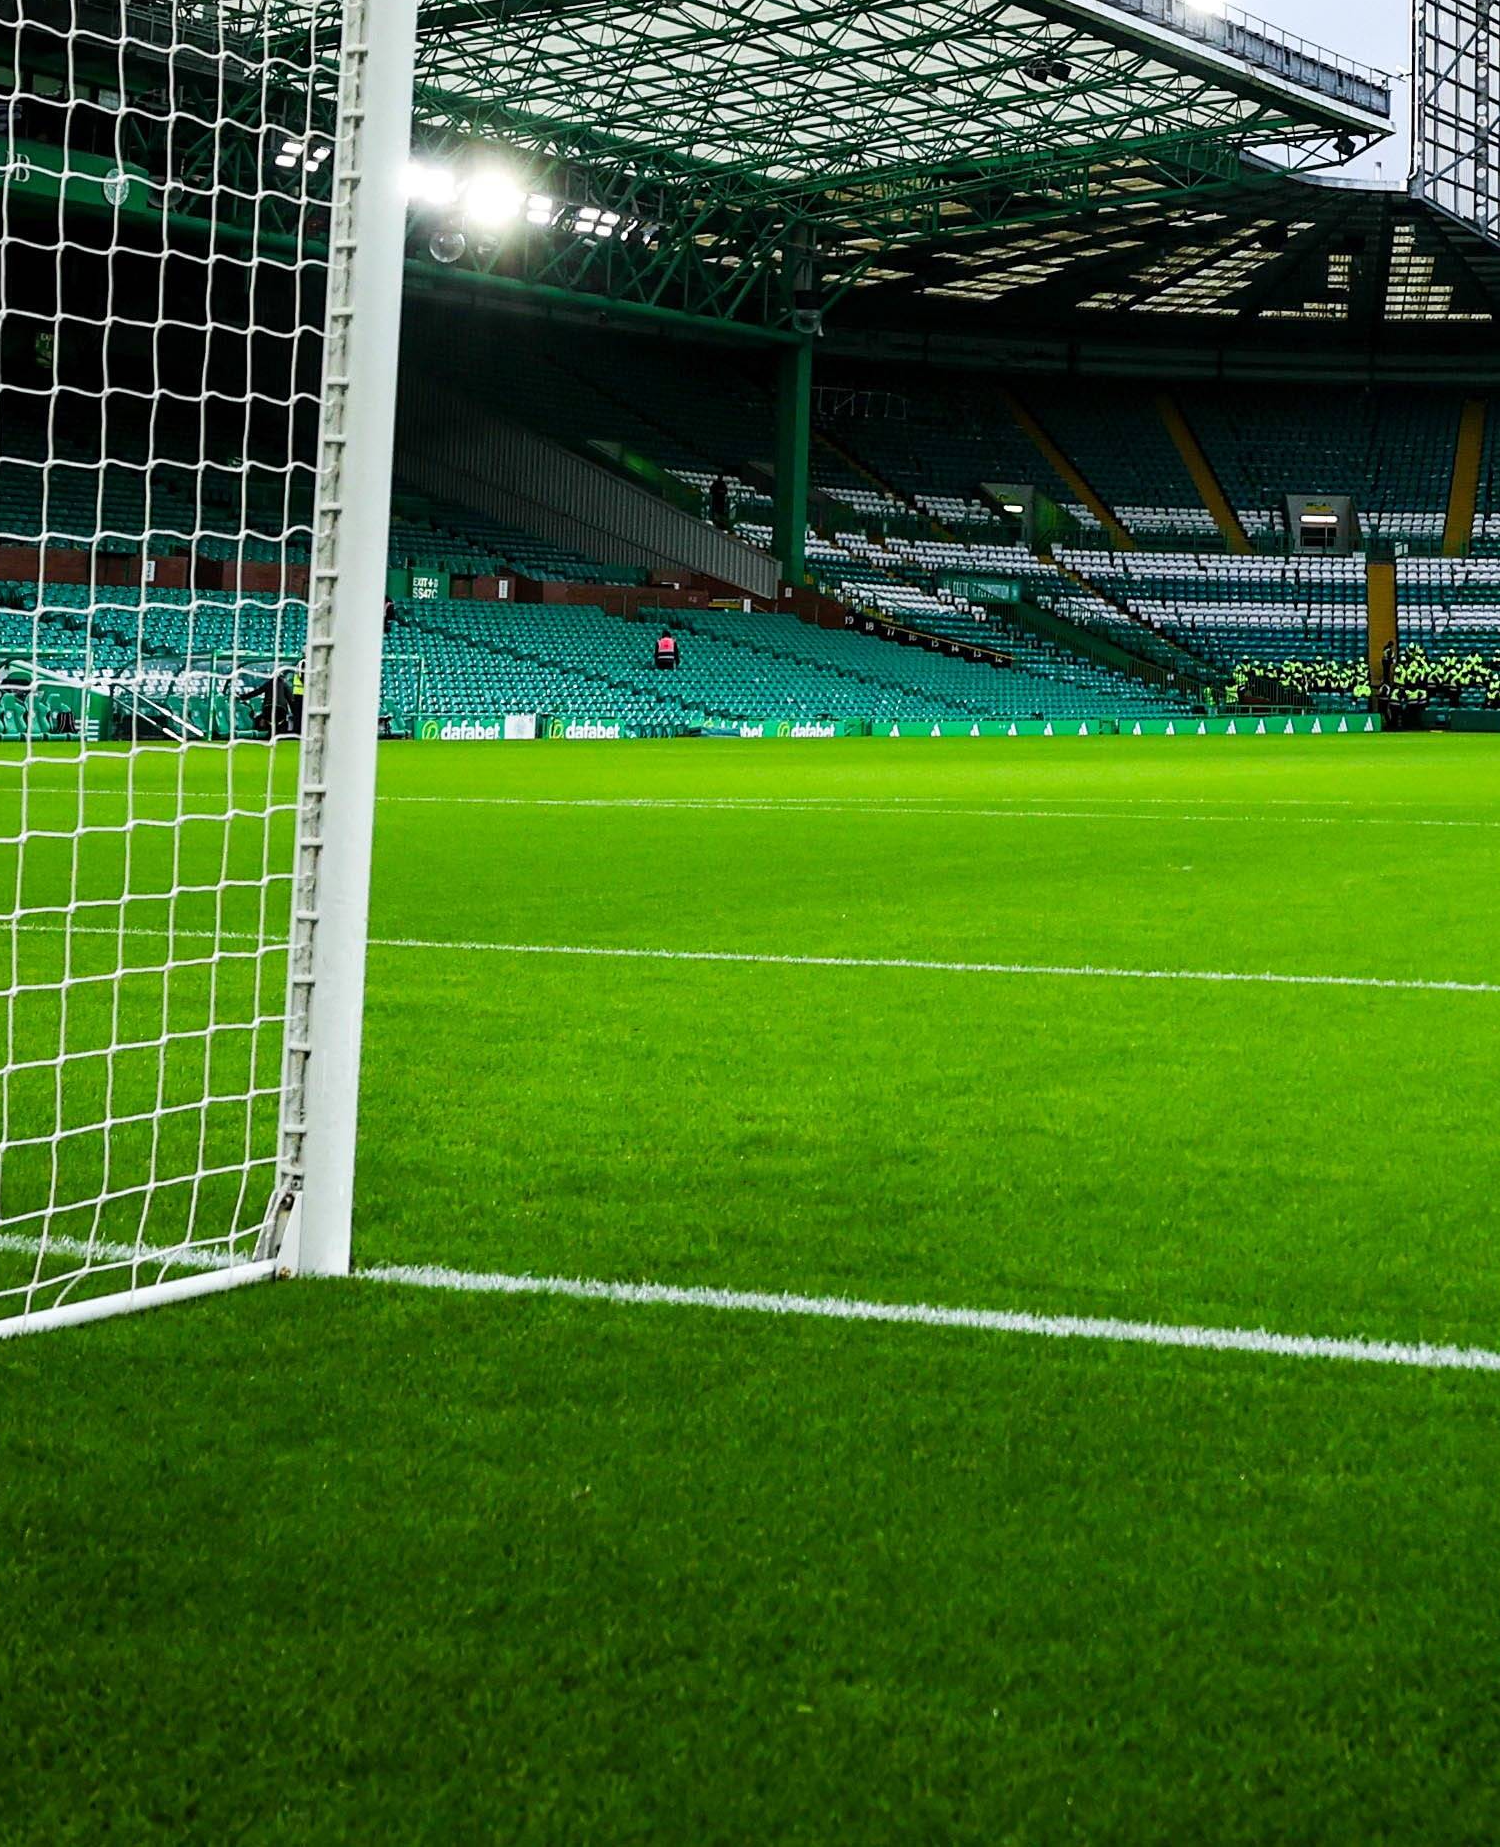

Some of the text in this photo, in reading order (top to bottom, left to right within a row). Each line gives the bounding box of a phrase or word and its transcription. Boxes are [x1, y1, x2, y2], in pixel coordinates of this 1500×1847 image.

[441, 720, 500, 740] dafabet
[566, 719, 620, 739] dafabet
[791, 721, 835, 738] dafabet
